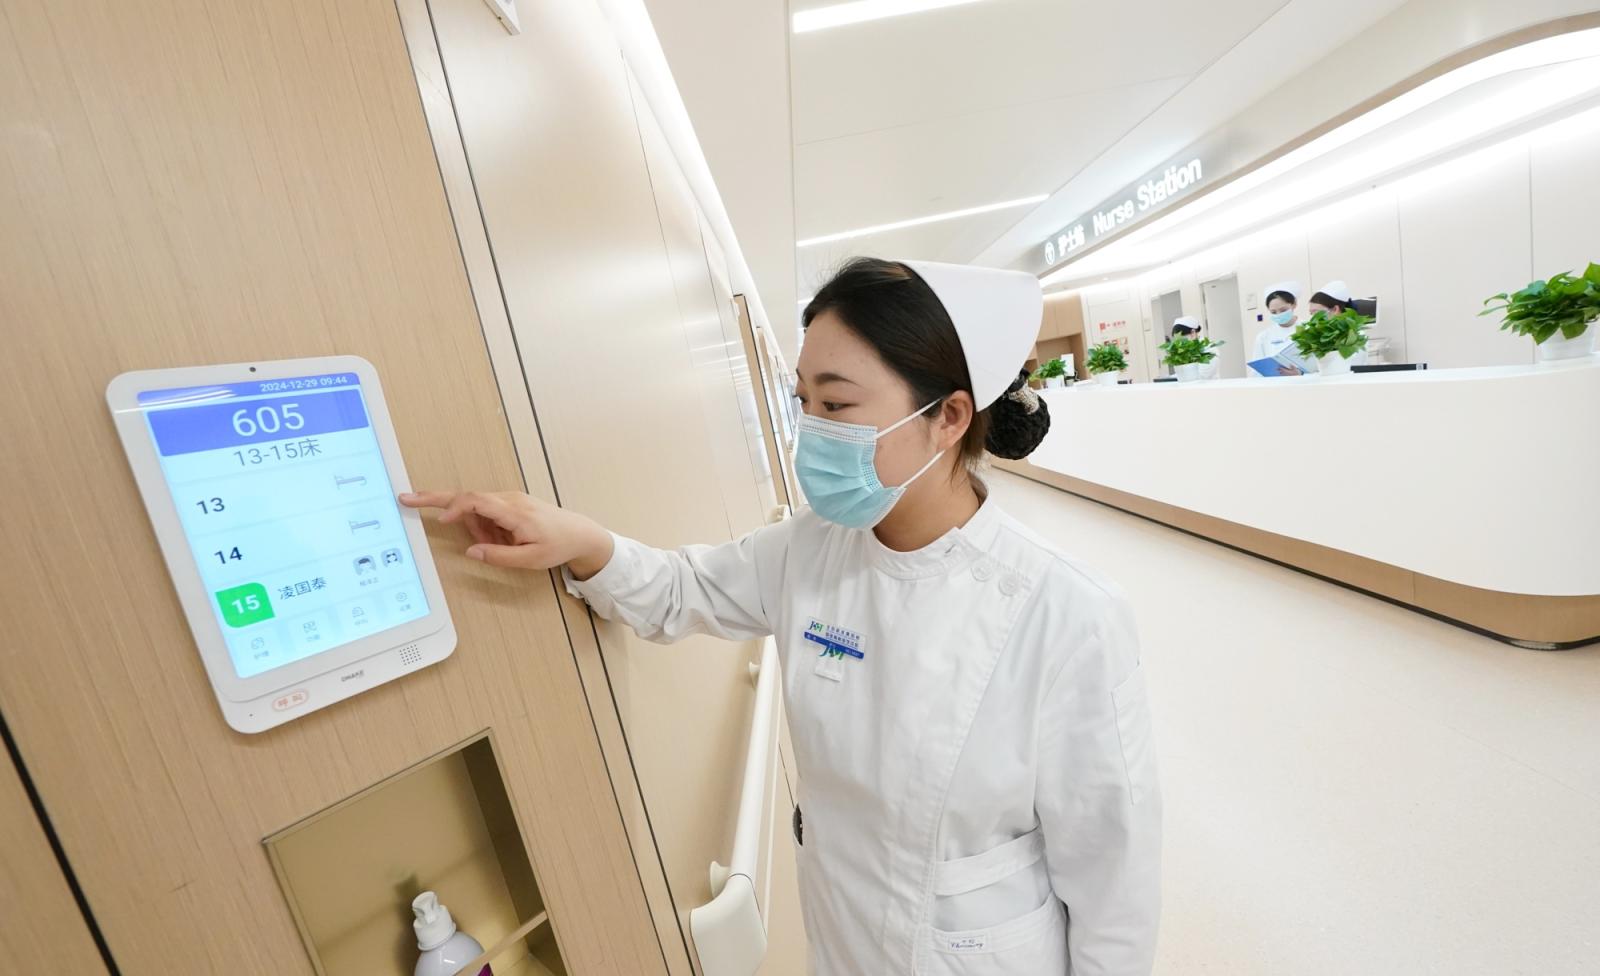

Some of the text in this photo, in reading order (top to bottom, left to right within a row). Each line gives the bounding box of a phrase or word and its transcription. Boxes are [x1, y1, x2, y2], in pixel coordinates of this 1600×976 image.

[1092, 158, 1202, 236] Nurse Station
[259, 375, 348, 393] 2024-12-29 09:44
[232, 403, 305, 437] 605
[233, 438, 323, 467] 13-15床
[196, 497, 226, 515] 13
[214, 546, 243, 565] 14
[277, 576, 327, 601] 凌国泰
[231, 594, 261, 615] 15
